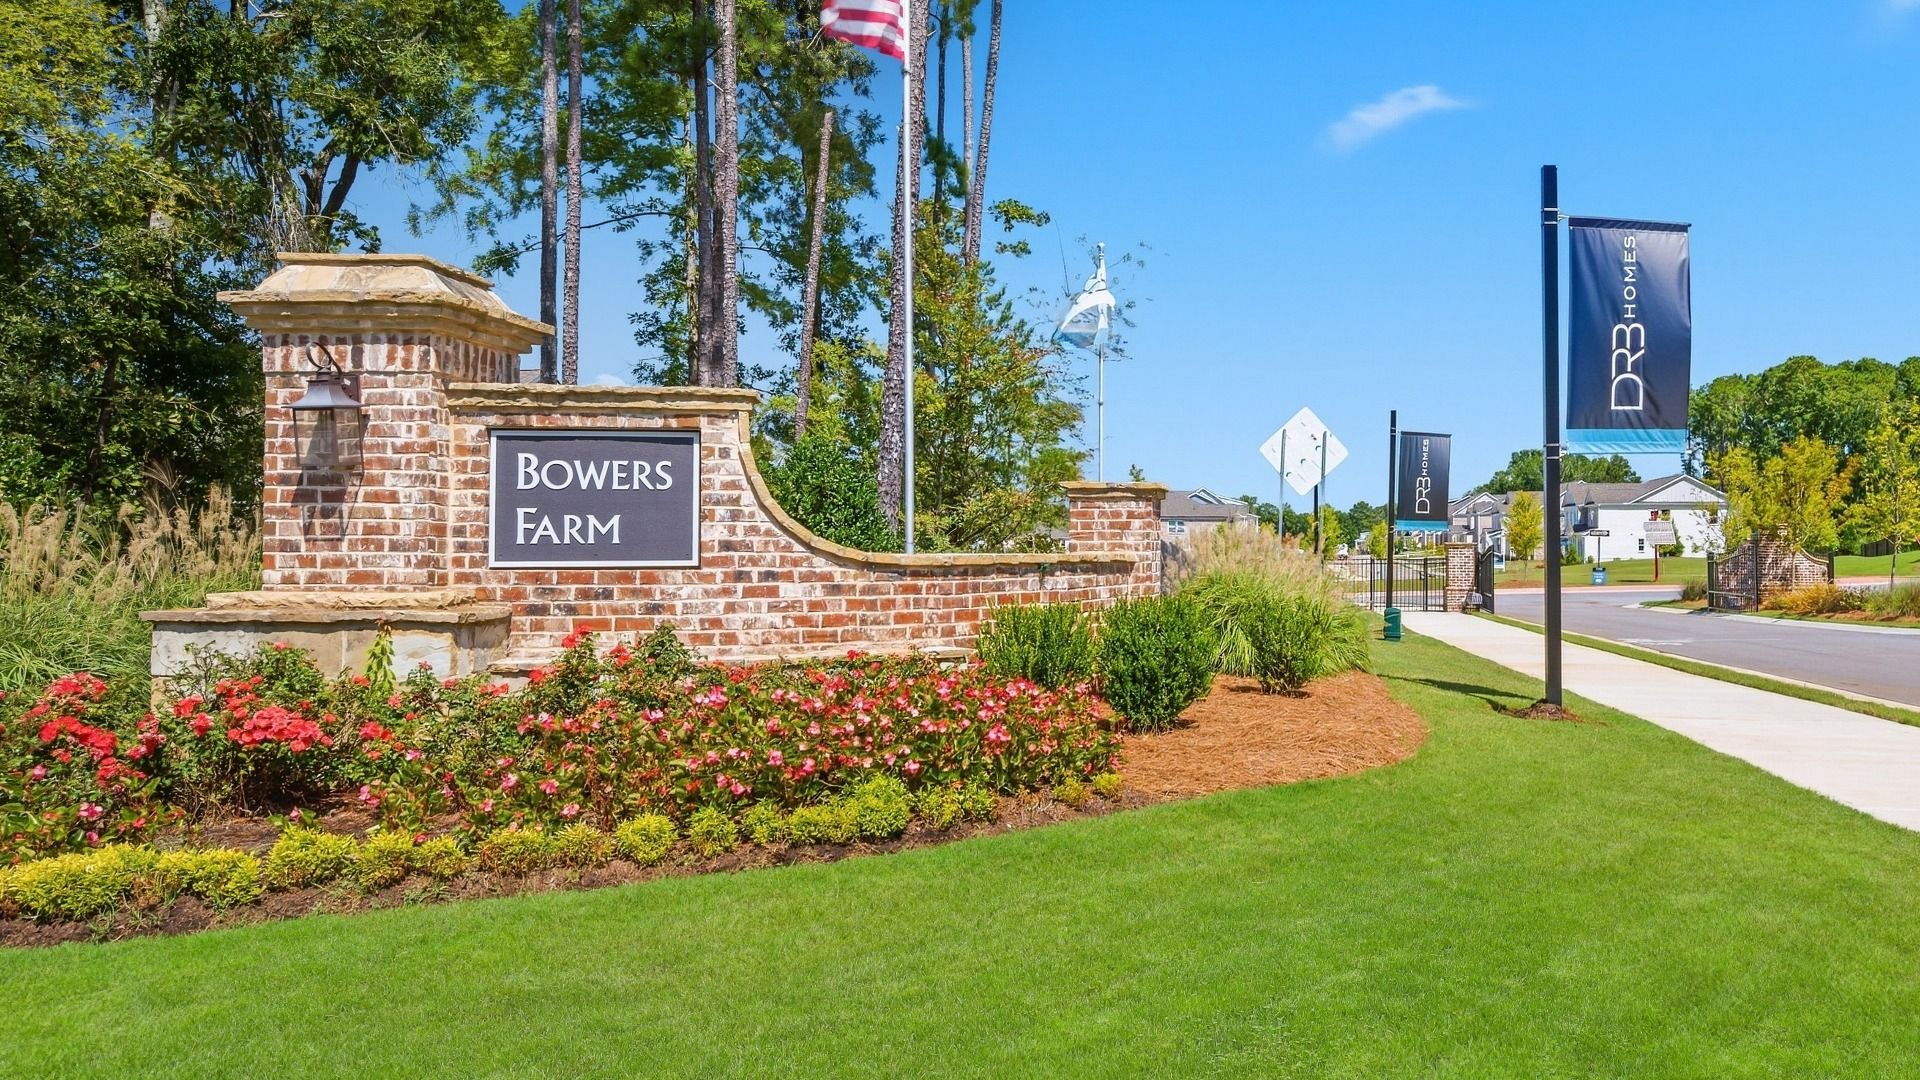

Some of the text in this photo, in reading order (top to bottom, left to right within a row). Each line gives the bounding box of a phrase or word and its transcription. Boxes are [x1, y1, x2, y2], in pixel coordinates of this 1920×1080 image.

[1611, 235, 1645, 411] DRB HOMES
[516, 452, 673, 490] BOWERS
[1415, 477, 1431, 514] DRB
[515, 507, 621, 545] FARM
